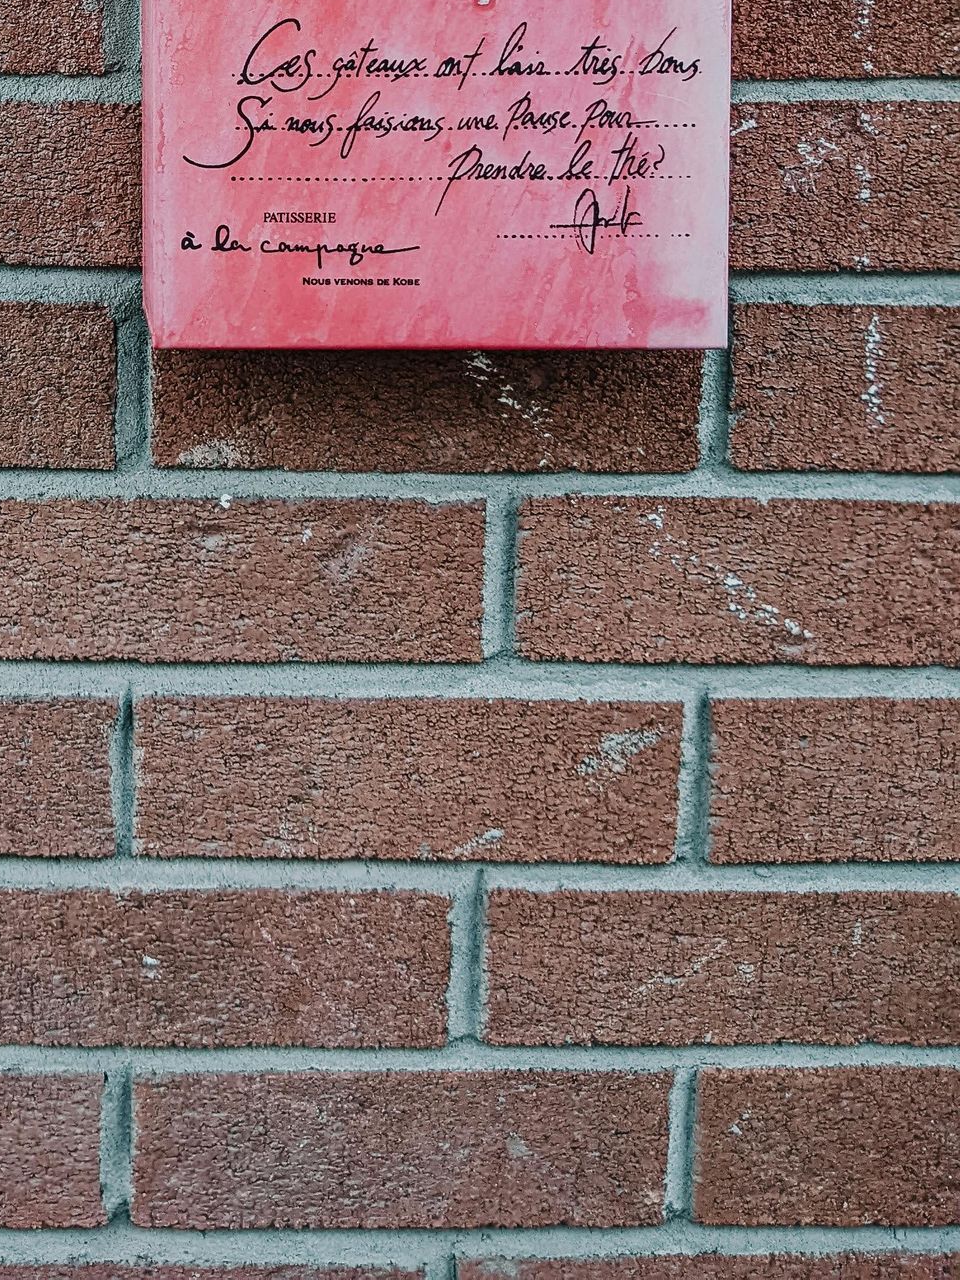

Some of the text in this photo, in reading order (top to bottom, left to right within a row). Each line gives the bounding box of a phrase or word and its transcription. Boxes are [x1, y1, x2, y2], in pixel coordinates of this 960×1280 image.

[307, 38, 428, 100] gâteaux
[436, 37, 486, 90] ont
[284, 113, 337, 147] nous
[456, 112, 499, 131] une
[263, 212, 337, 224] PATISSERIE
[180, 231, 203, 251] à
[210, 224, 252, 252] la
